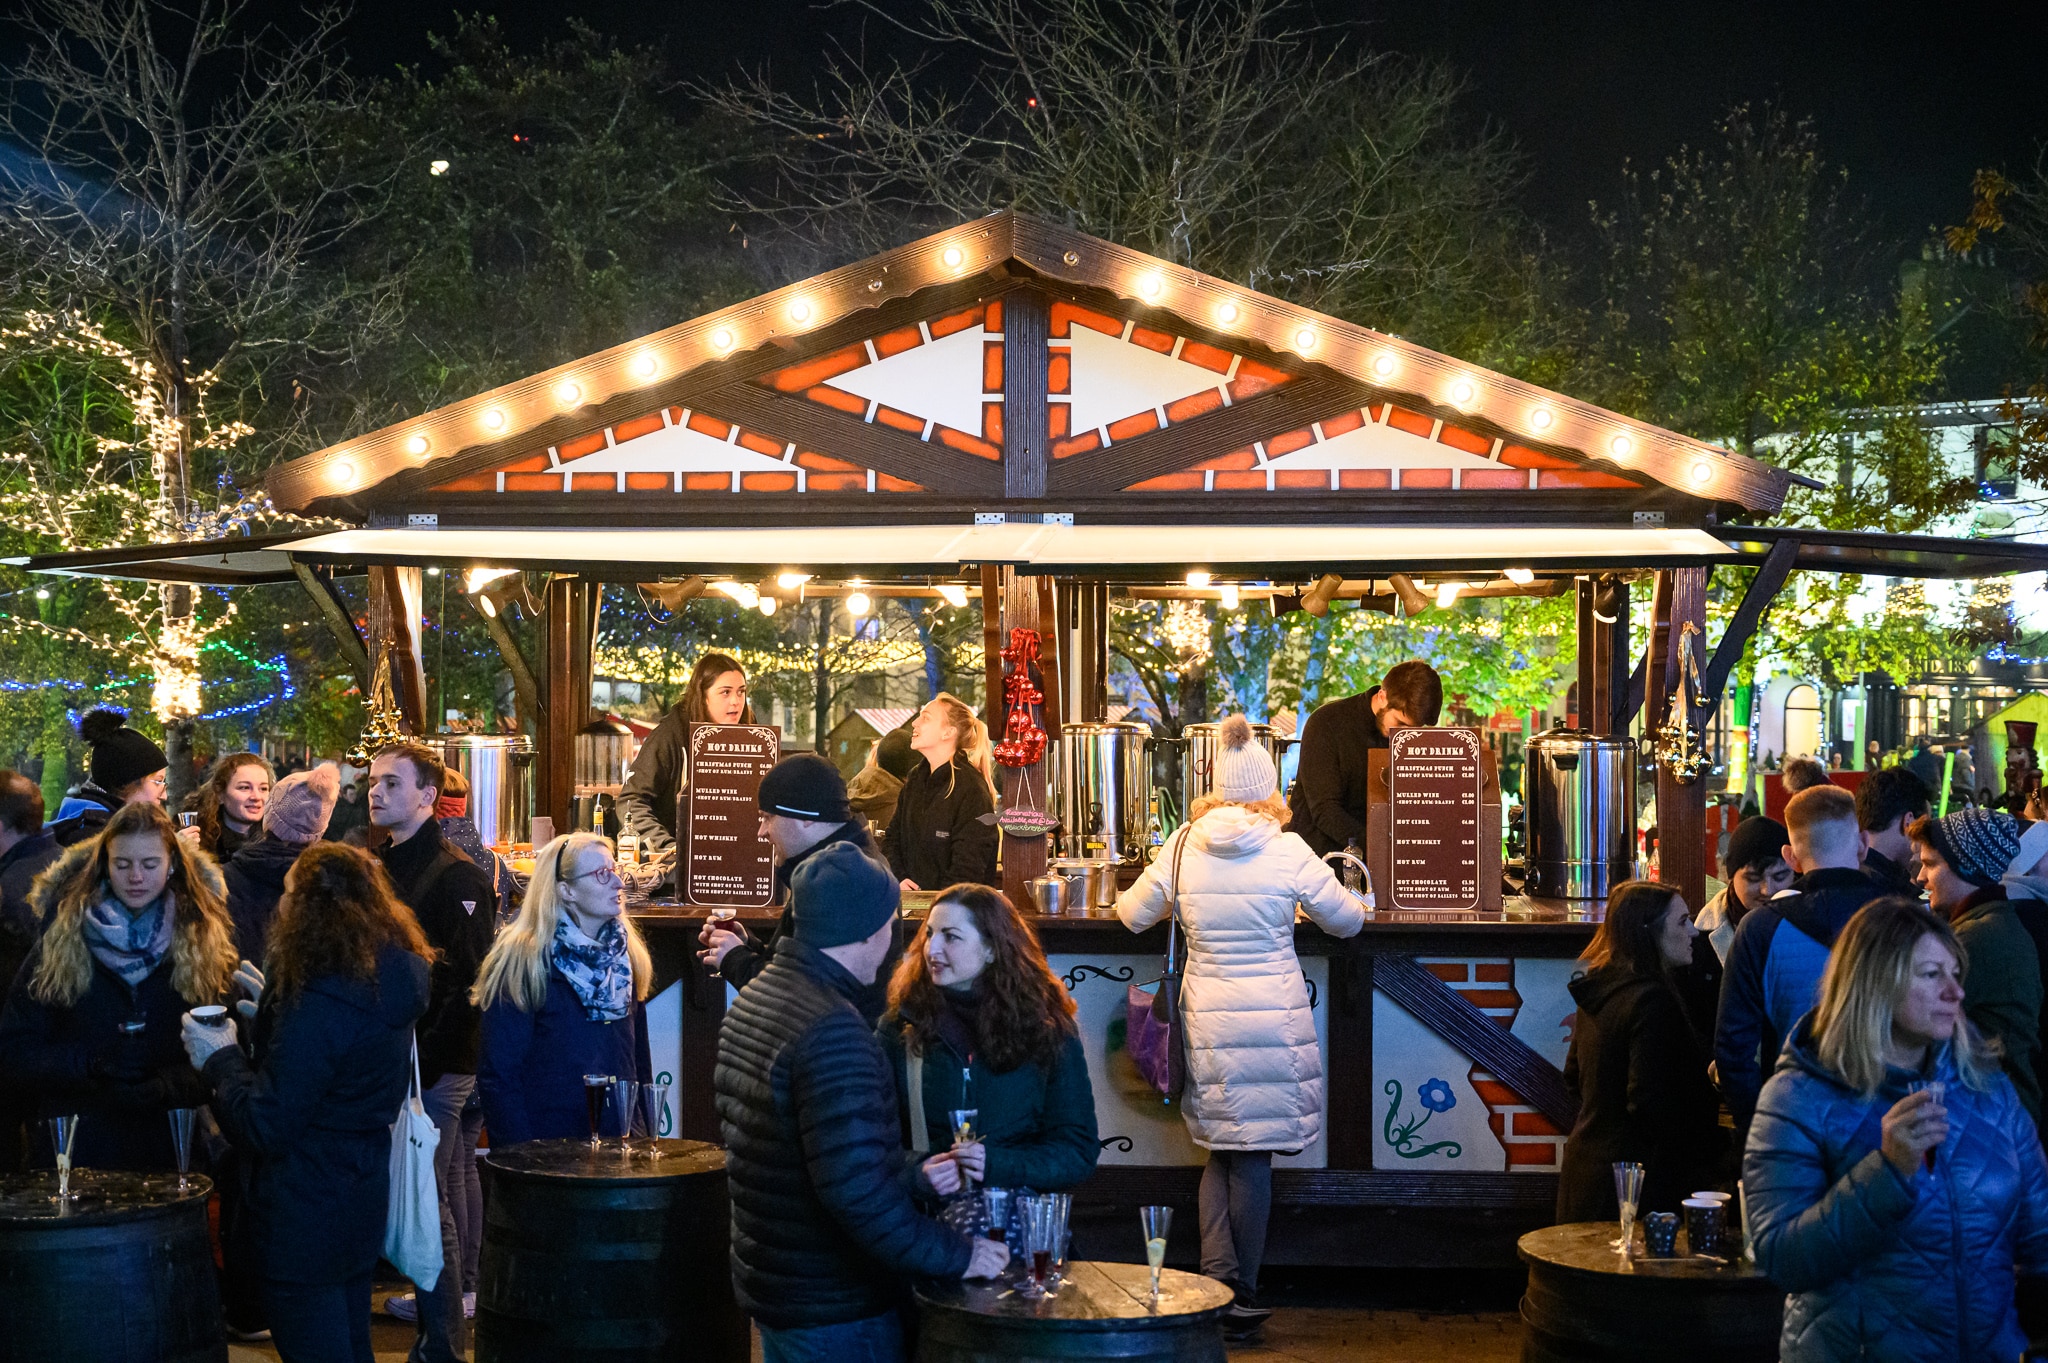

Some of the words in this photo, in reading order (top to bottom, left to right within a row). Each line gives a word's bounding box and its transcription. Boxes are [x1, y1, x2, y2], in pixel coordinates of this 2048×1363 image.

[707, 743, 726, 751] HOT
[729, 744, 762, 753] DRINKS
[1407, 747, 1427, 756] HOT
[1430, 747, 1464, 756] DRINKS
